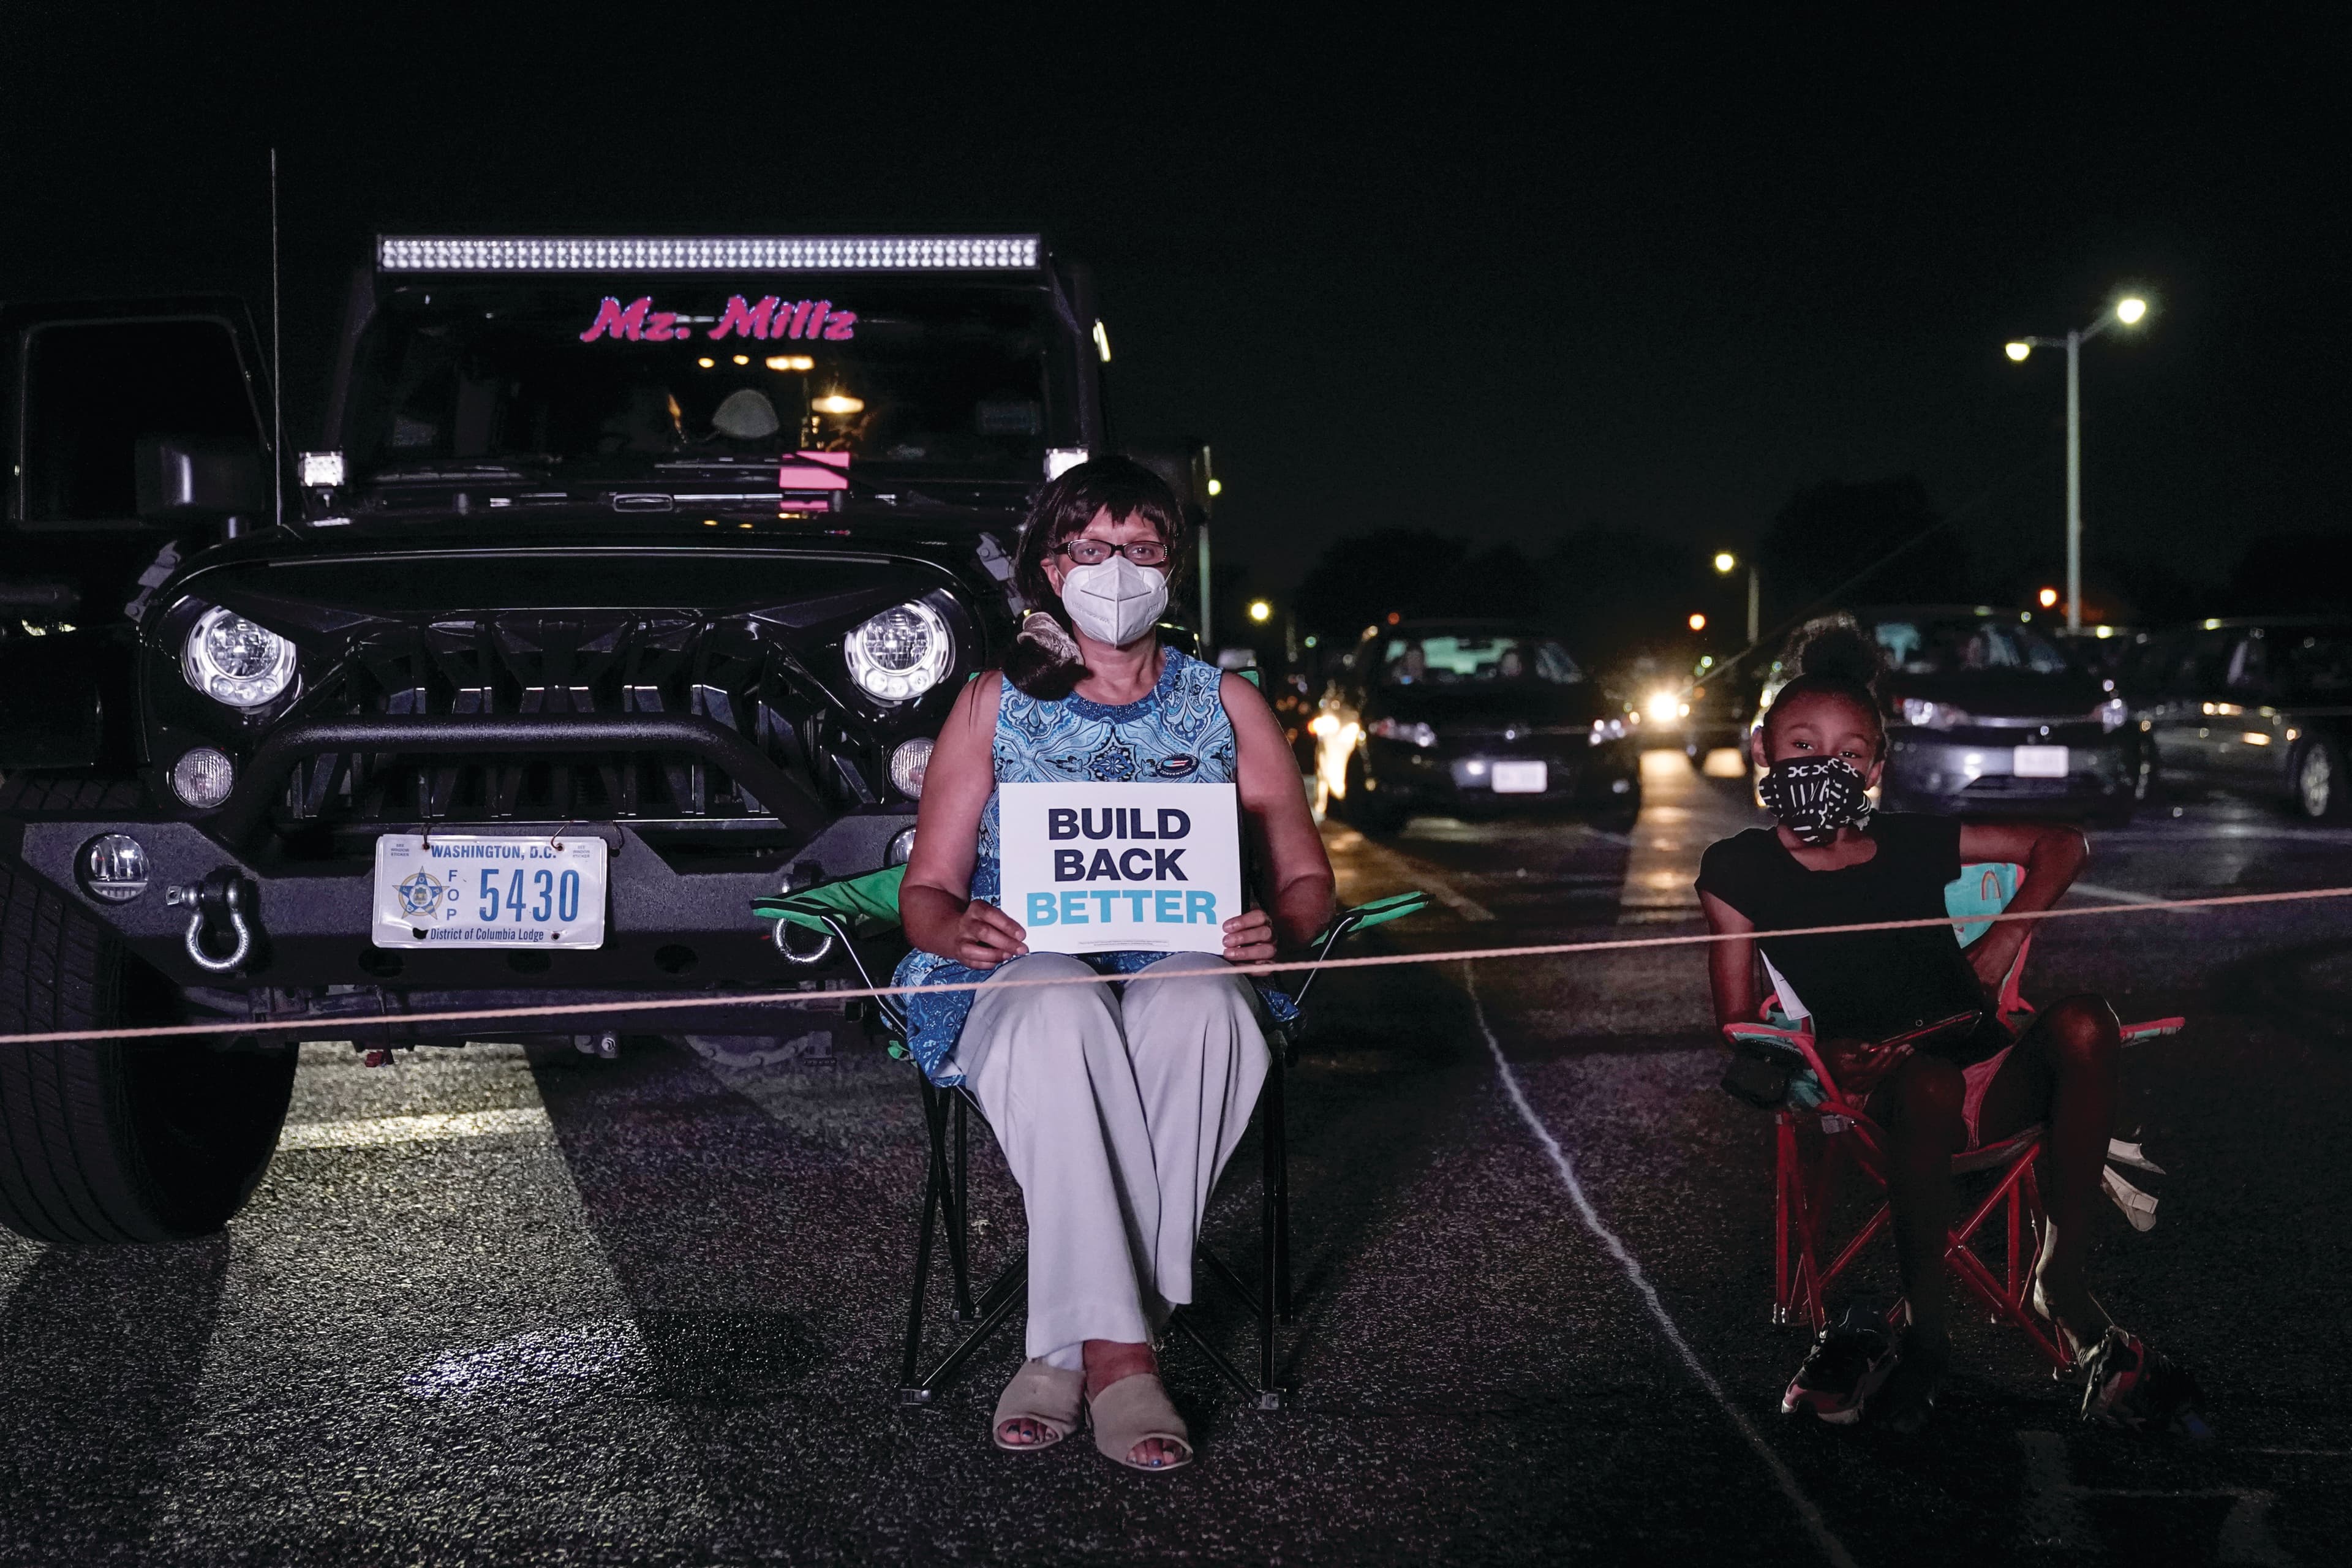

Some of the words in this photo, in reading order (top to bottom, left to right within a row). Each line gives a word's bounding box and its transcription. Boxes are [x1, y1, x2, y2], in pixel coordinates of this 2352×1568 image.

[579, 296, 691, 342] Mz.
[707, 295, 857, 341] Millz
[1048, 808, 1191, 840] BUILD
[431, 845, 525, 861] WASHINGTON,
[530, 846, 557, 859] D.C.
[1054, 848, 1189, 881] BACK
[479, 869, 579, 922] 5430
[1027, 889, 1217, 927] BETTER
[431, 927, 463, 940] District
[464, 928, 475, 940] of
[476, 929, 516, 941] Columbia
[518, 930, 544, 942] Lodge
